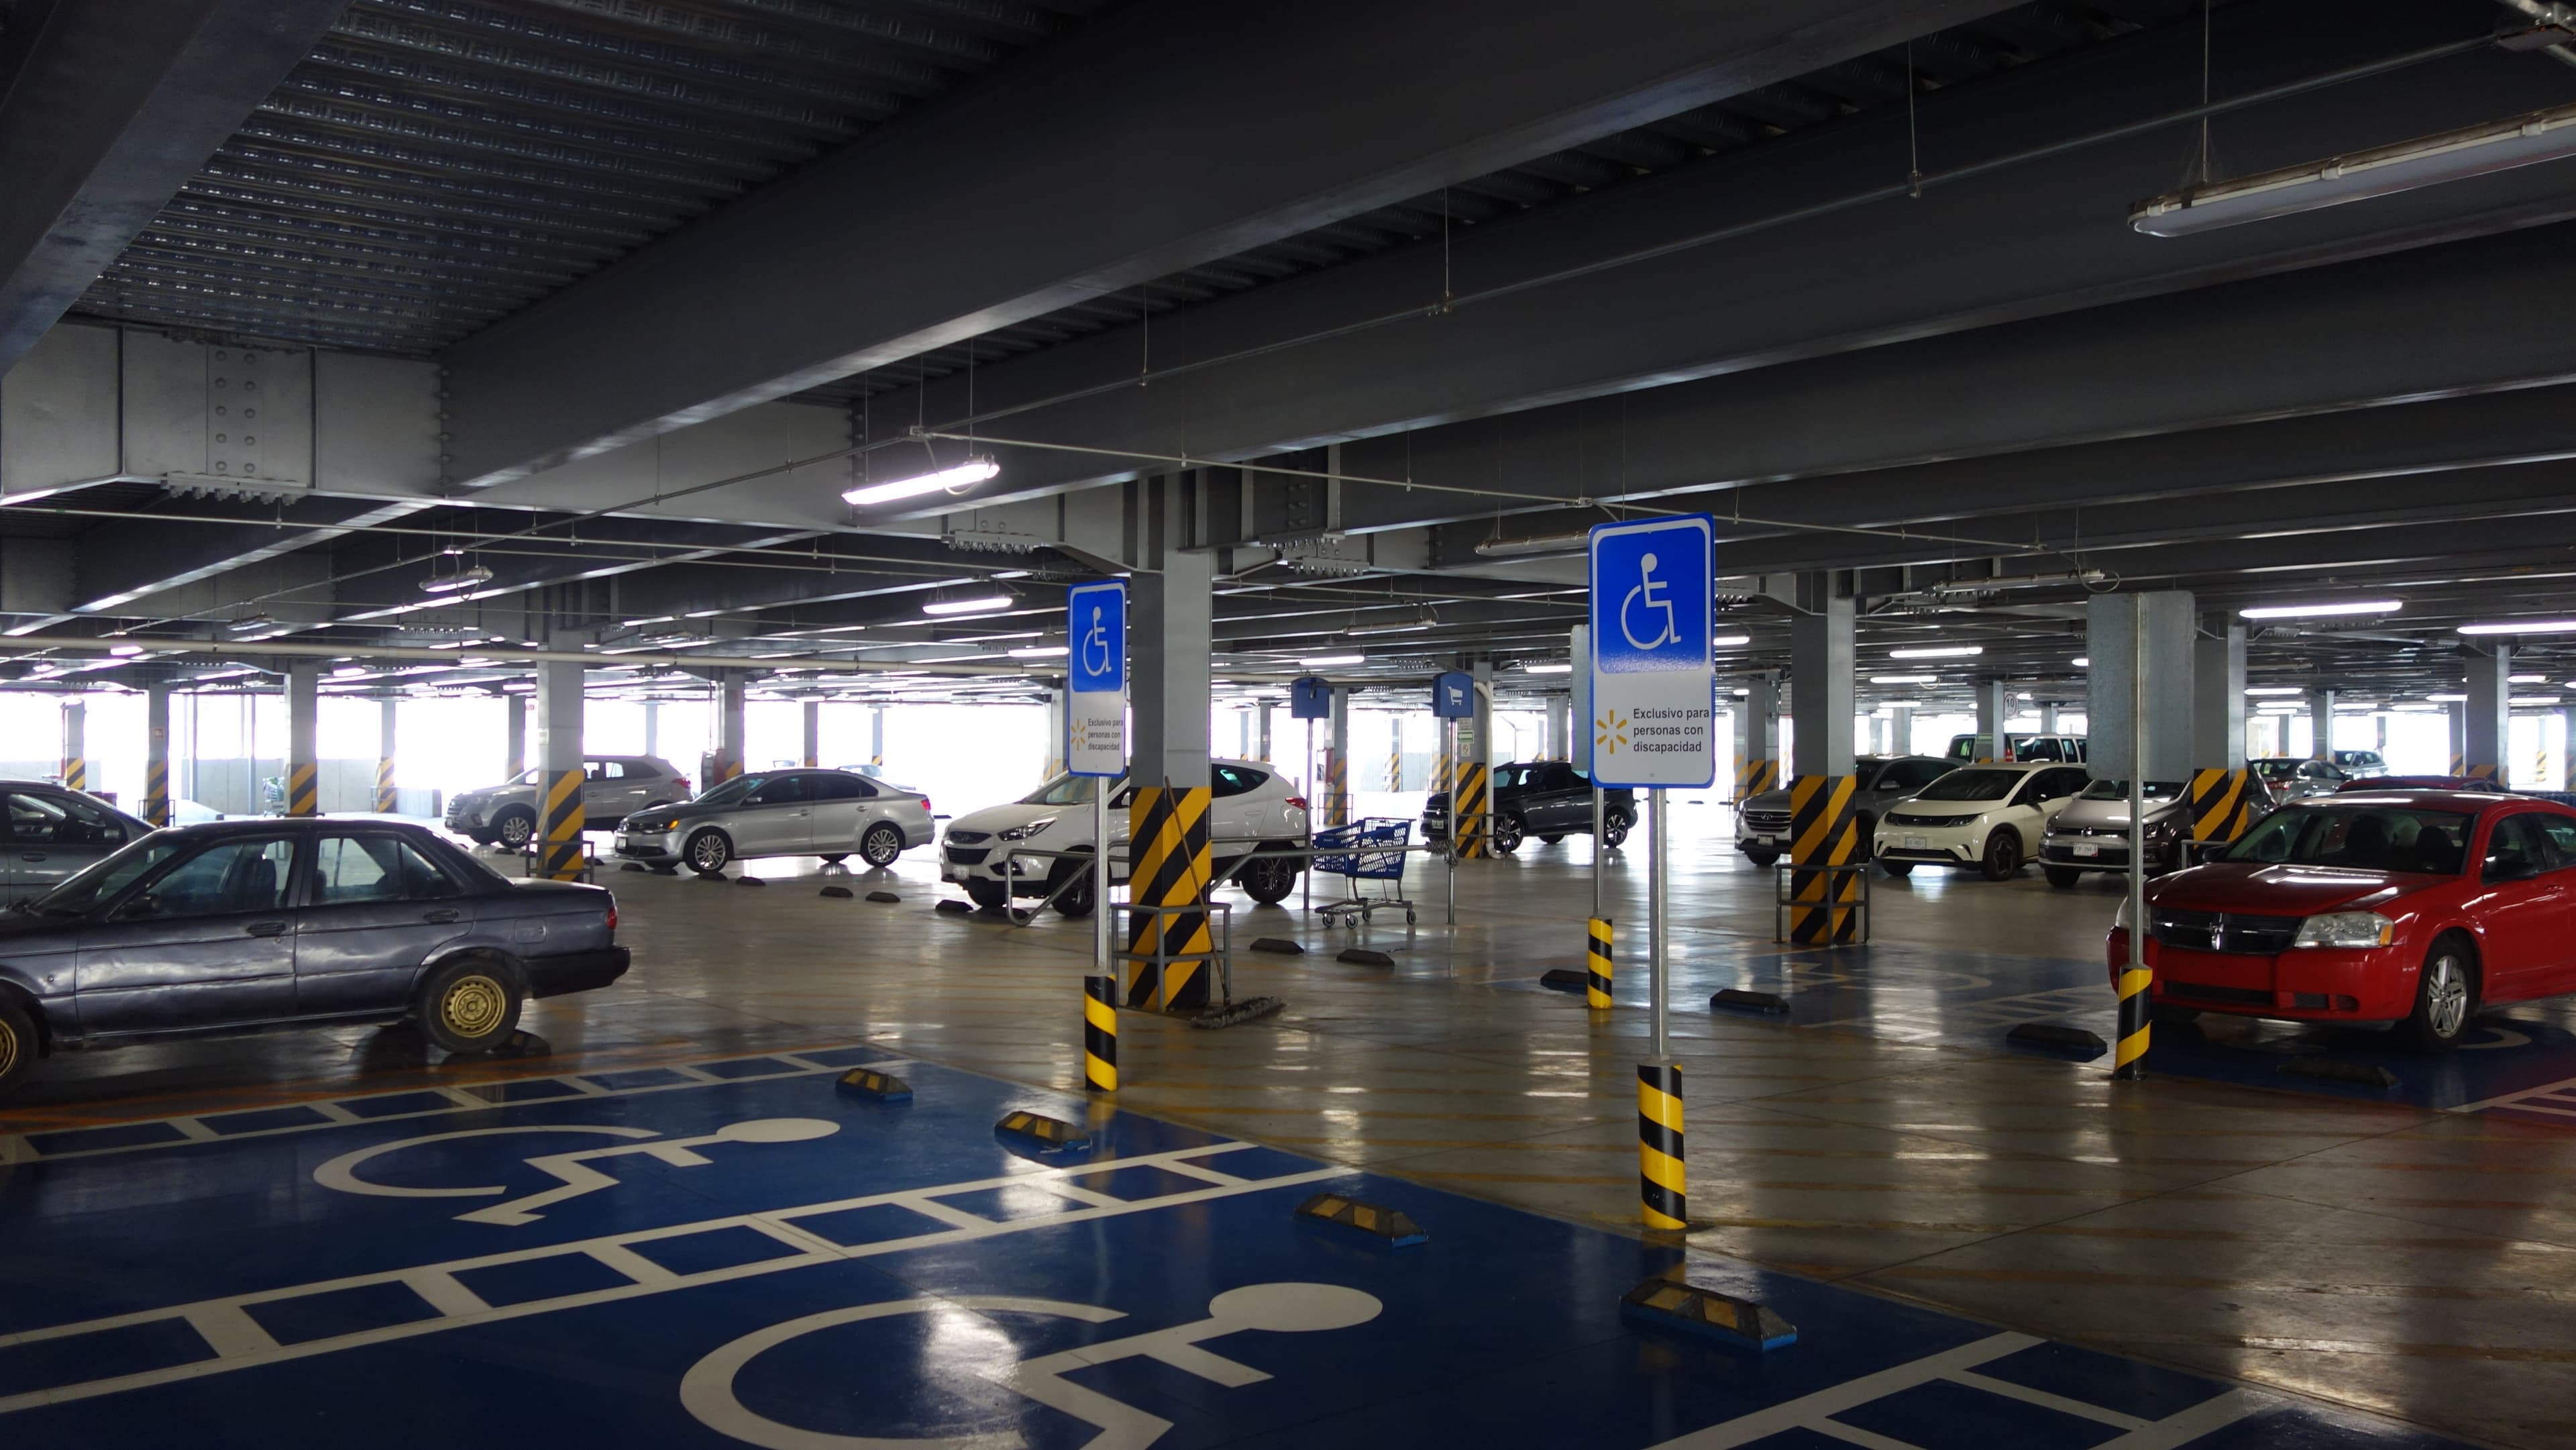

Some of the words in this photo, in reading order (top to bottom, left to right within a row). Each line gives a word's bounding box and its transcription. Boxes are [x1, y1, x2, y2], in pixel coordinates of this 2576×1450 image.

[2006, 698, 2015, 708] 10
[1633, 707, 1683, 719] Exclusivo
[1686, 709, 1709, 721] para
[1087, 718, 1112, 726] Exclusivo
[1112, 719, 1124, 727] para
[1087, 731, 1110, 740] personas
[1633, 726, 1680, 738] personas
[1684, 726, 1703, 735] con
[1087, 742, 1120, 751] discapacidad
[1633, 741, 1702, 755] discapacidad
